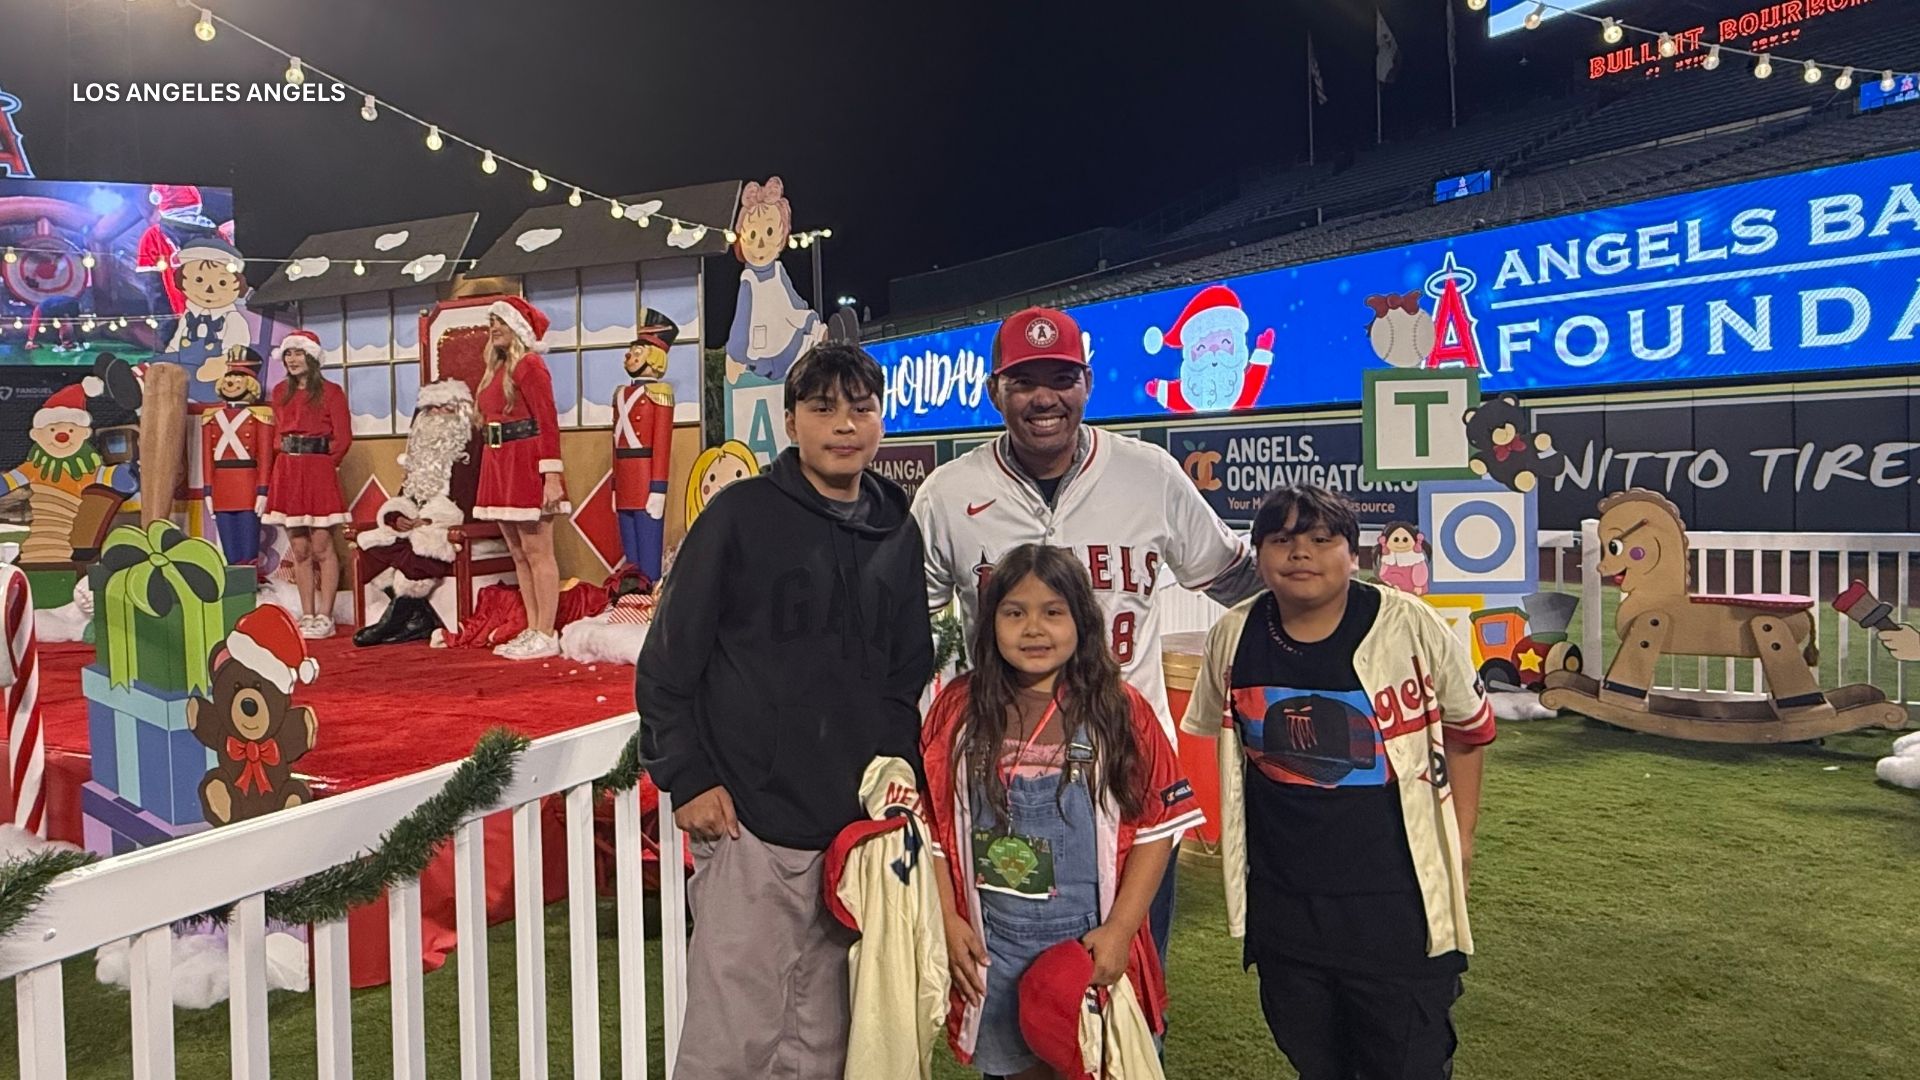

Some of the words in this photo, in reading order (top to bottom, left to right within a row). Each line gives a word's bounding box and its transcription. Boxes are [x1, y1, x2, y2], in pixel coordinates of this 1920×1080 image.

[1589, 27, 1704, 79] BULLIT
[1719, 0, 1872, 43] BOURBO
[1492, 208, 1779, 291] ANGELS
[881, 349, 990, 420] HOLIDAY
[748, 398, 778, 462] A
[1225, 435, 1320, 463] ANGELS.
[1394, 391, 1449, 457] T
[867, 460, 926, 480] HANGA
[1554, 439, 1730, 492] NITTO
[1750, 442, 1920, 494] TIRE
[1228, 497, 1251, 510] Your
[1440, 500, 1516, 573] O
